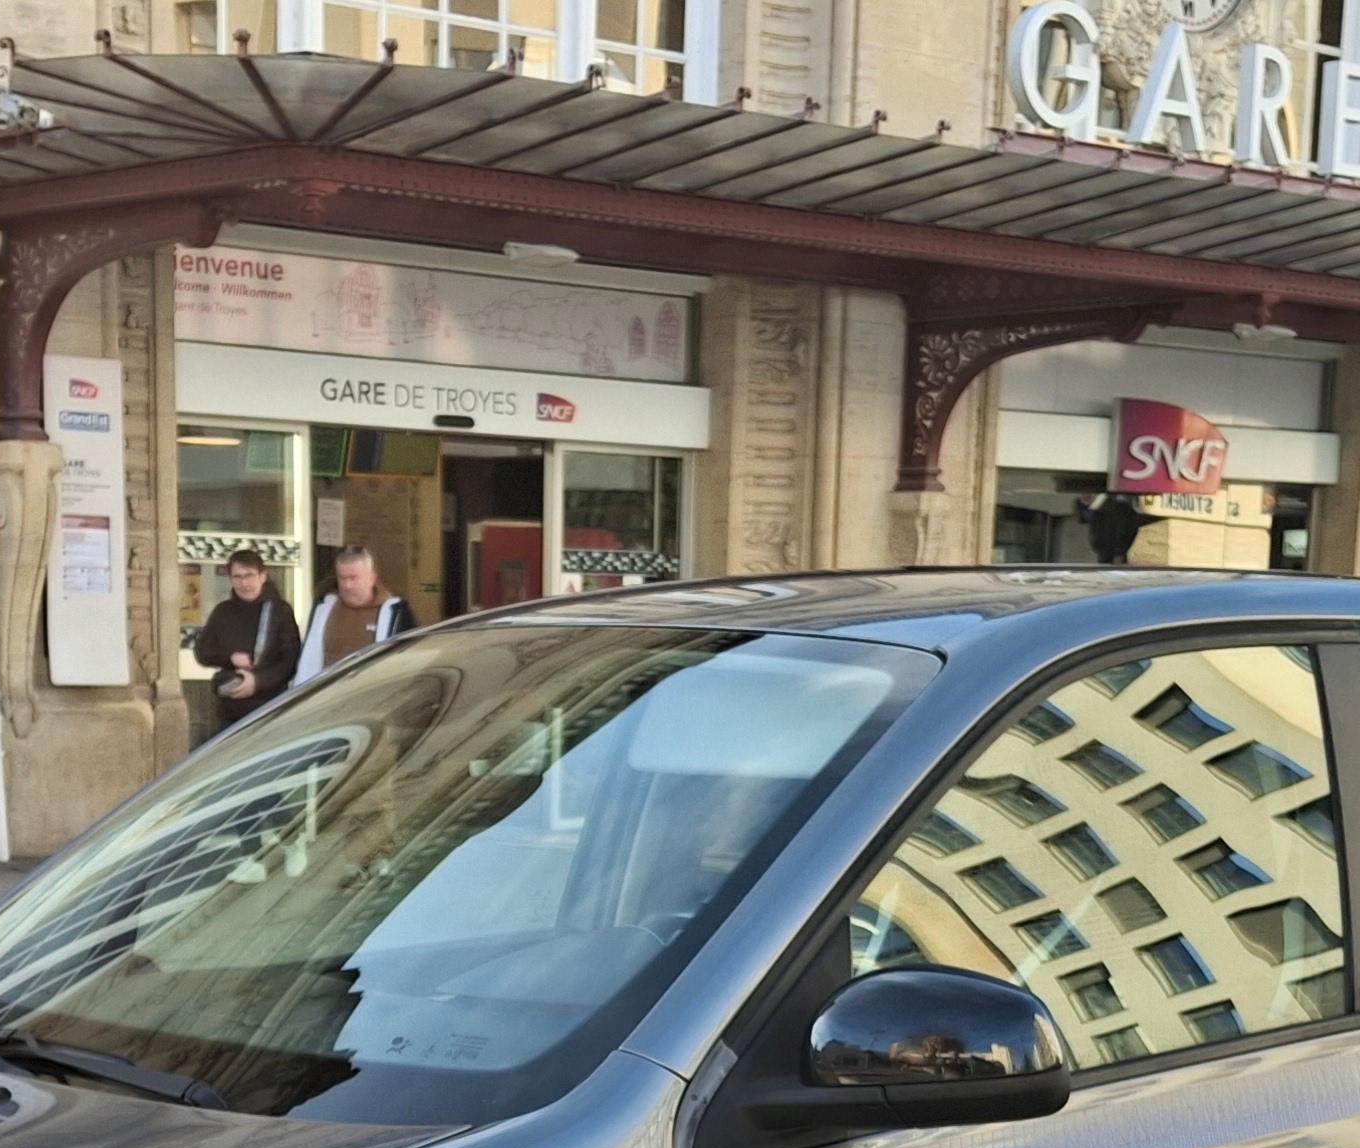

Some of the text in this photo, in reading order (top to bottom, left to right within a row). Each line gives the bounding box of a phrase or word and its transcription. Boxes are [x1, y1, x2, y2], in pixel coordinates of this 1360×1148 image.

[173, 247, 284, 281] ienvenue
[221, 282, 292, 300] Willkommen
[320, 378, 573, 420] GARE DE TROYES SNCF
[1122, 435, 1226, 482] SNCF
